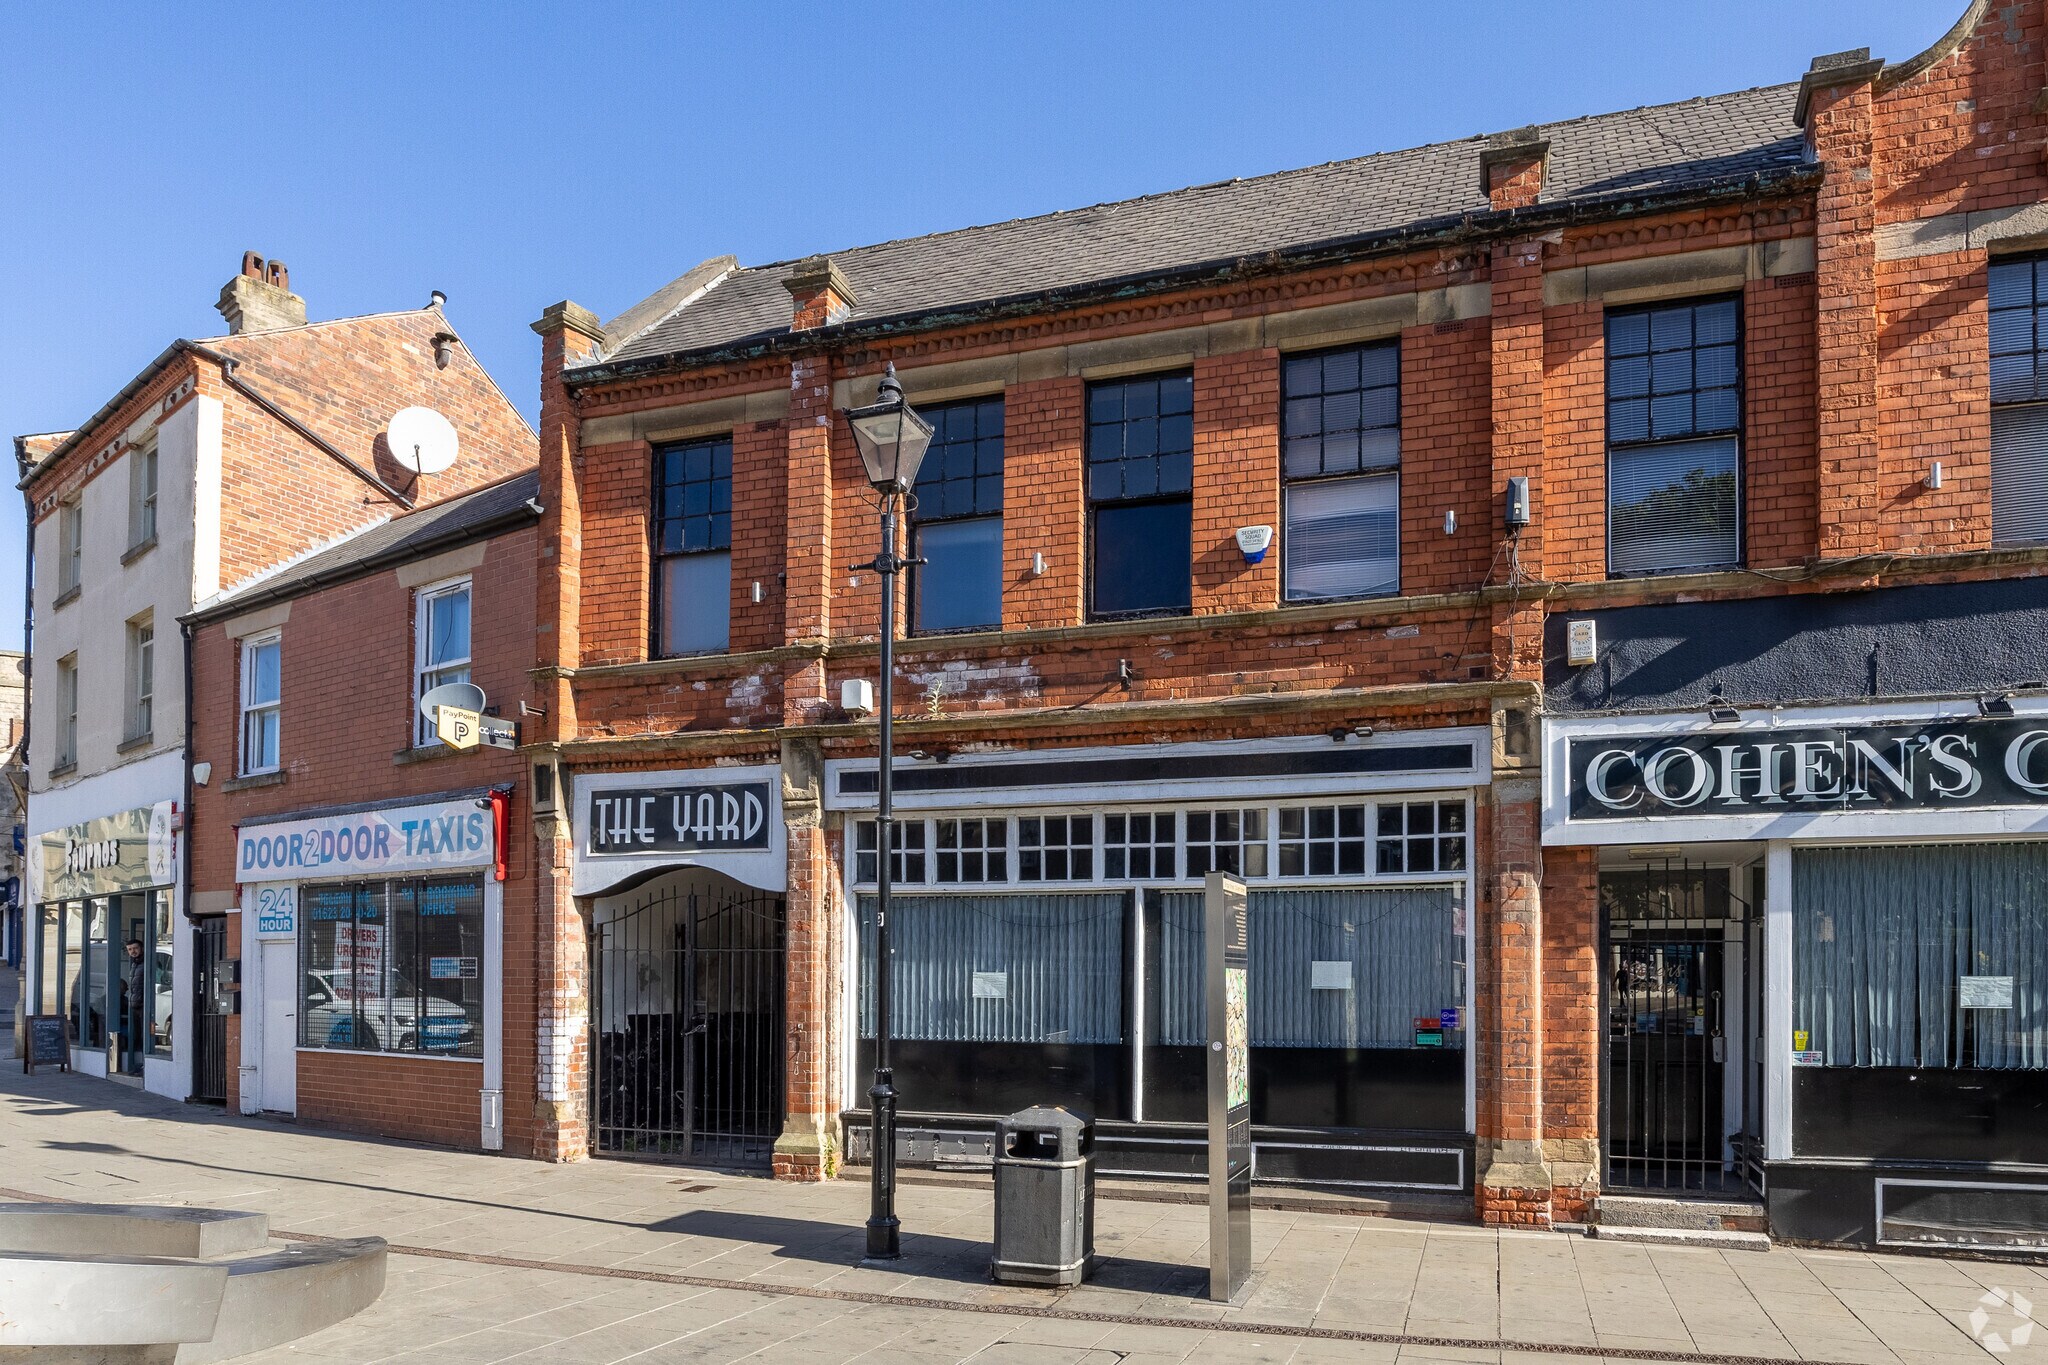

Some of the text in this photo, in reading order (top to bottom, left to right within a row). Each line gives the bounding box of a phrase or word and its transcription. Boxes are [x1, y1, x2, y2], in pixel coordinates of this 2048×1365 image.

[442, 708, 477, 722] PayPoint
[1585, 733, 1981, 809] COHEN'S
[595, 790, 764, 845] THE YARD
[242, 811, 484, 871] DOOR2DOOR TAXIS
[259, 887, 294, 918] 24
[318, 889, 371, 906] TELEPHNE
[260, 918, 292, 931] HOUR
[341, 927, 378, 943] DRVERS
[340, 960, 377, 977] WTED
